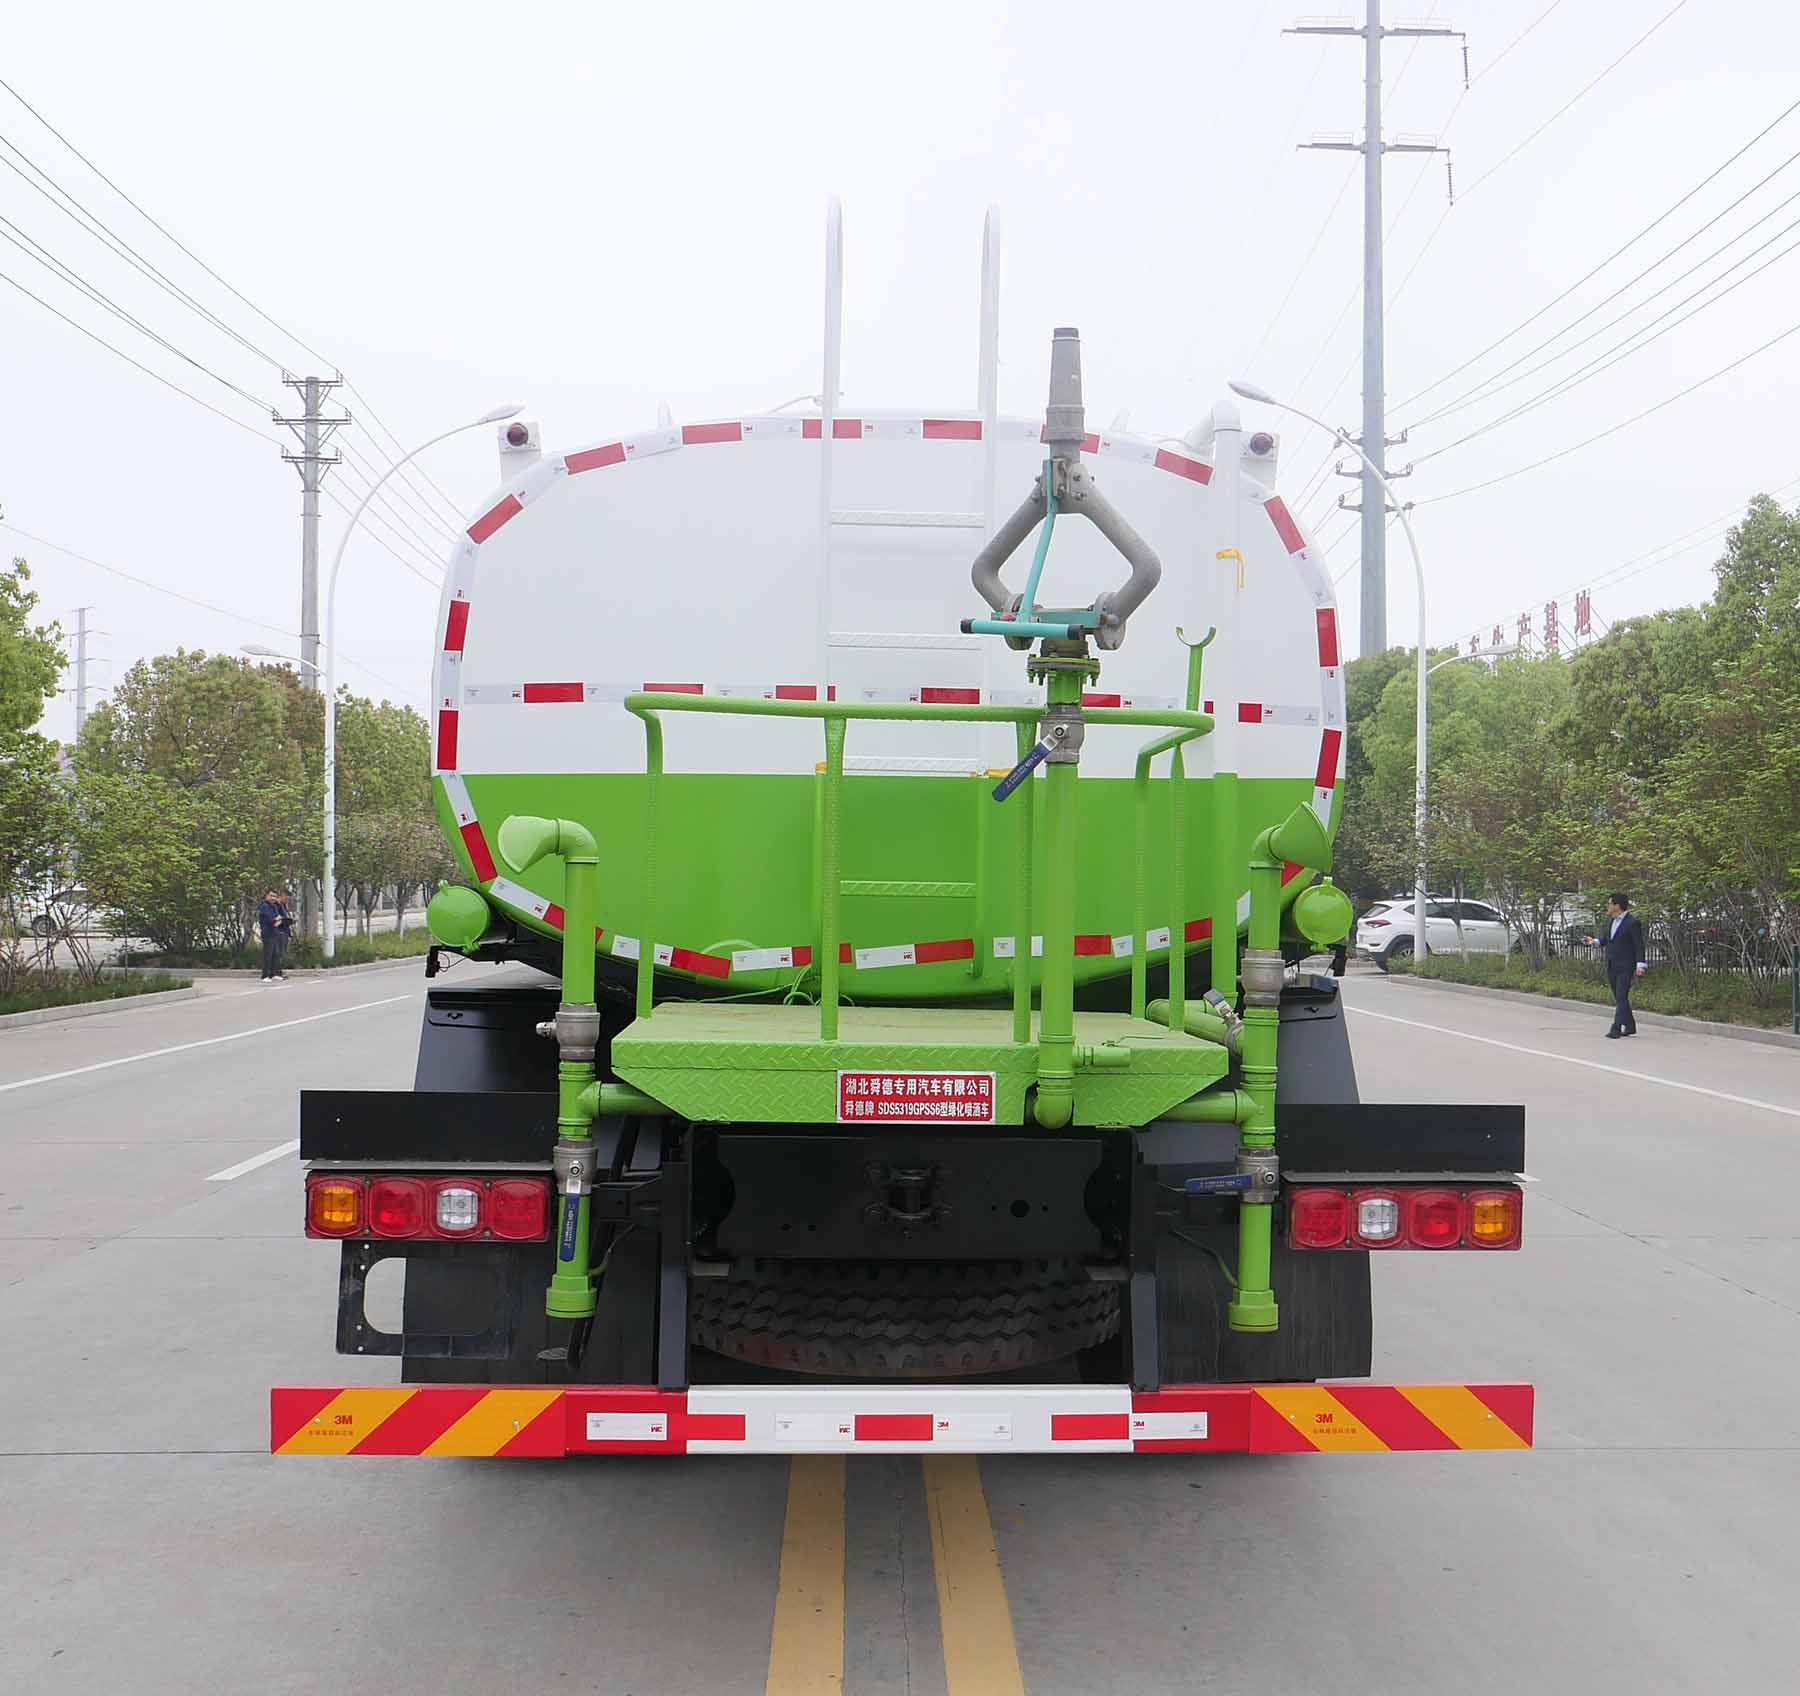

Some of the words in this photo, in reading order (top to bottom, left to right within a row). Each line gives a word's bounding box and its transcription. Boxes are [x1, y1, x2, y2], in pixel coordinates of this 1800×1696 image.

[845, 1078, 989, 1096] 湖北舜德专用汽车有限公司
[335, 1415, 352, 1424] 3M
[1315, 1414, 1332, 1423] 3M
